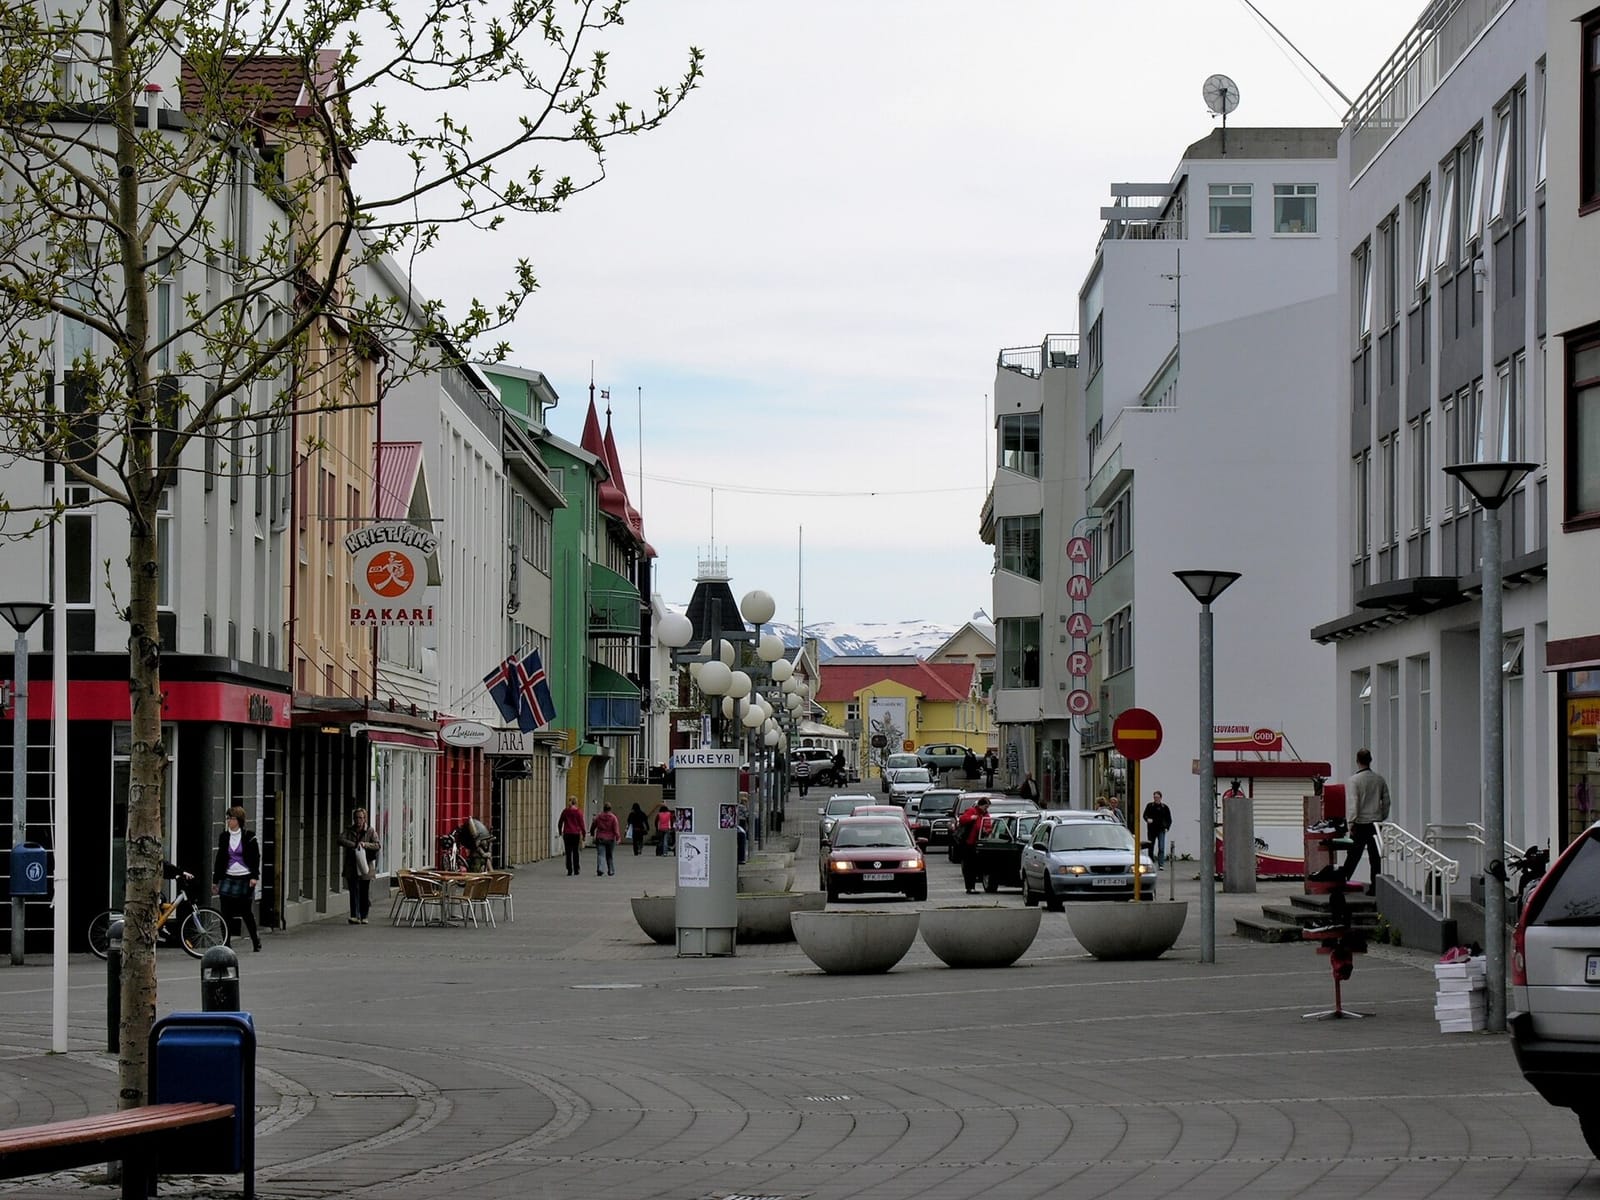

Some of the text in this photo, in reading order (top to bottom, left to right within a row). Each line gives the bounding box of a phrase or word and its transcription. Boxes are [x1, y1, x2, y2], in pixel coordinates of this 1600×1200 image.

[345, 525, 438, 554] KRISTJÁNS
[351, 606, 432, 620] BAKARÍ
[1070, 539, 1090, 711] AMARO
[497, 732, 524, 752] JARA
[675, 754, 734, 764] AKUREYRI
